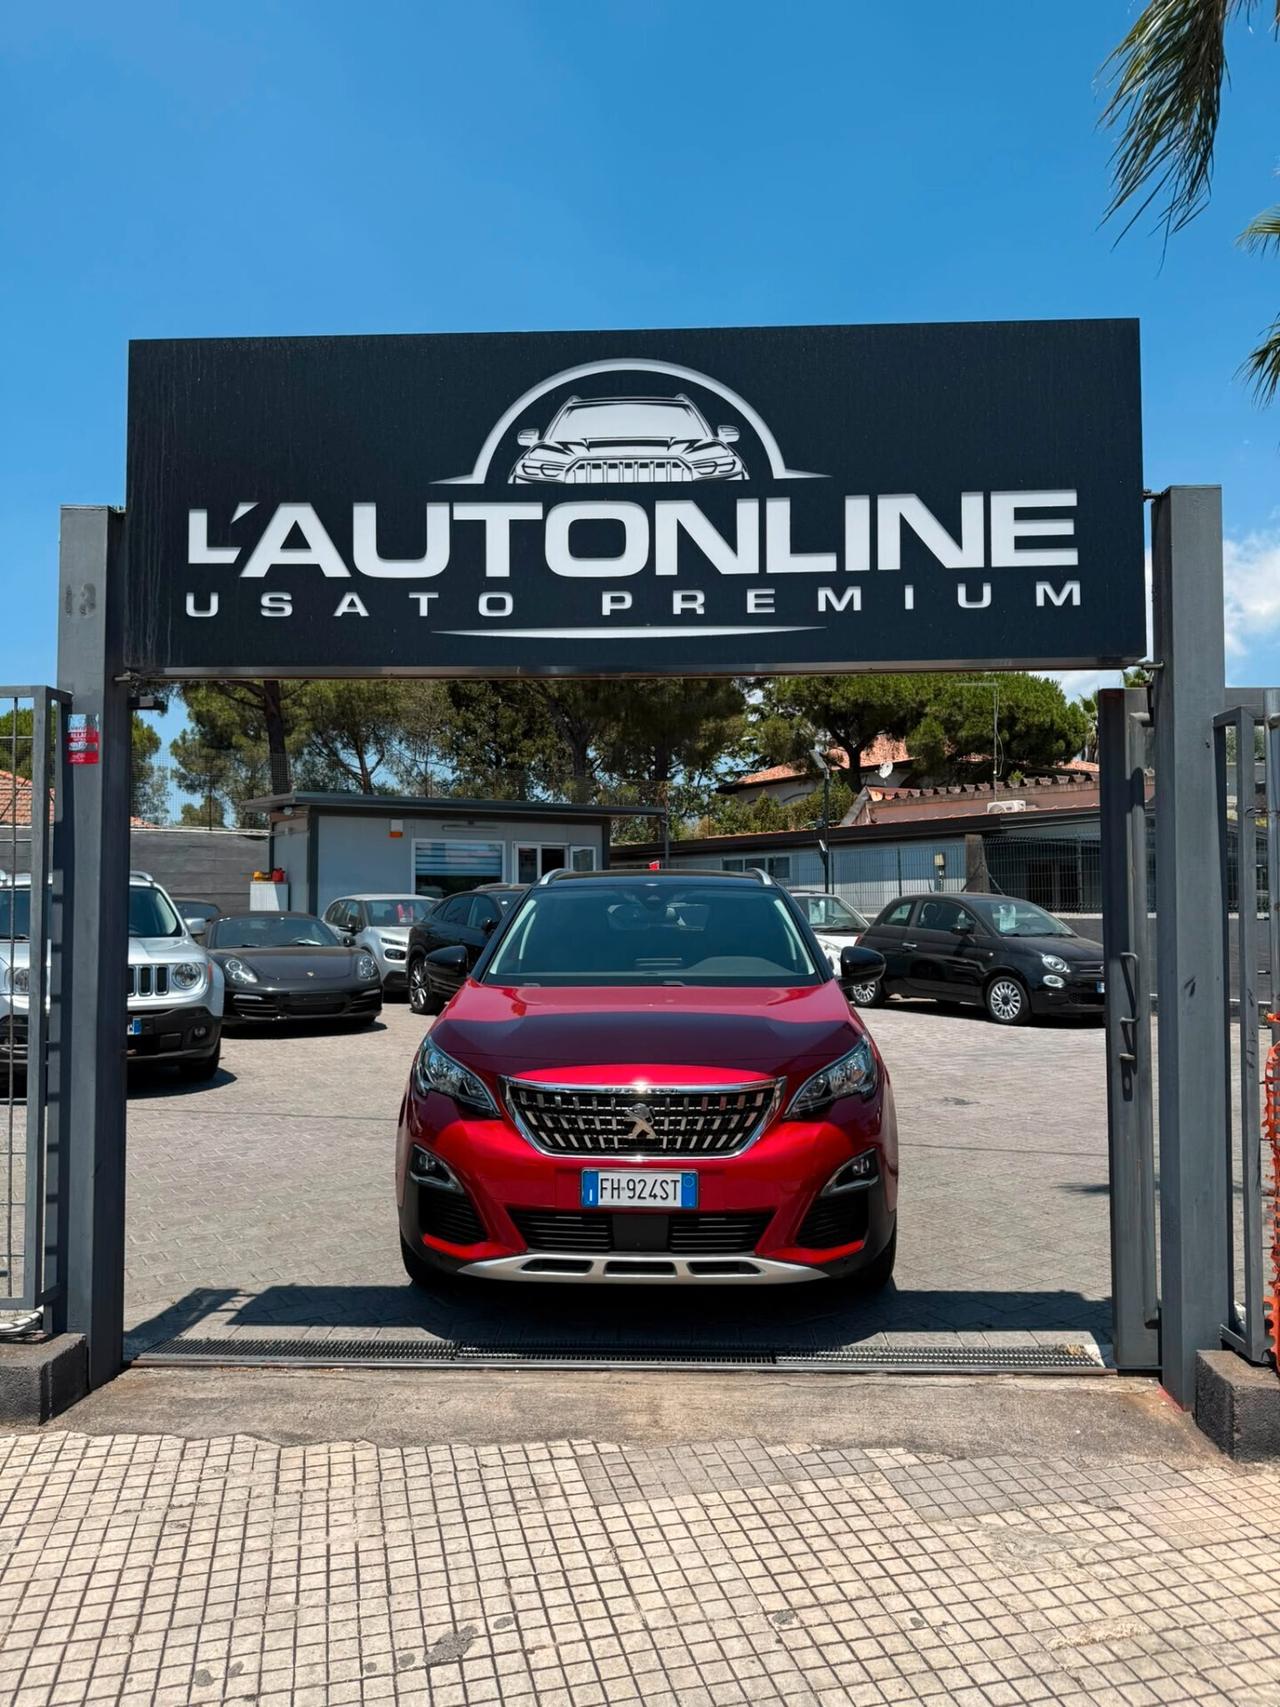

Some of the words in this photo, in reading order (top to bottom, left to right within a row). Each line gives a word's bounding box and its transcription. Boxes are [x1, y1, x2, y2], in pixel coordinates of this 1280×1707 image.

[187, 489, 1079, 579] L'AUTONLINE
[185, 591, 514, 618] USATO
[601, 580, 1082, 616] PREMIUM
